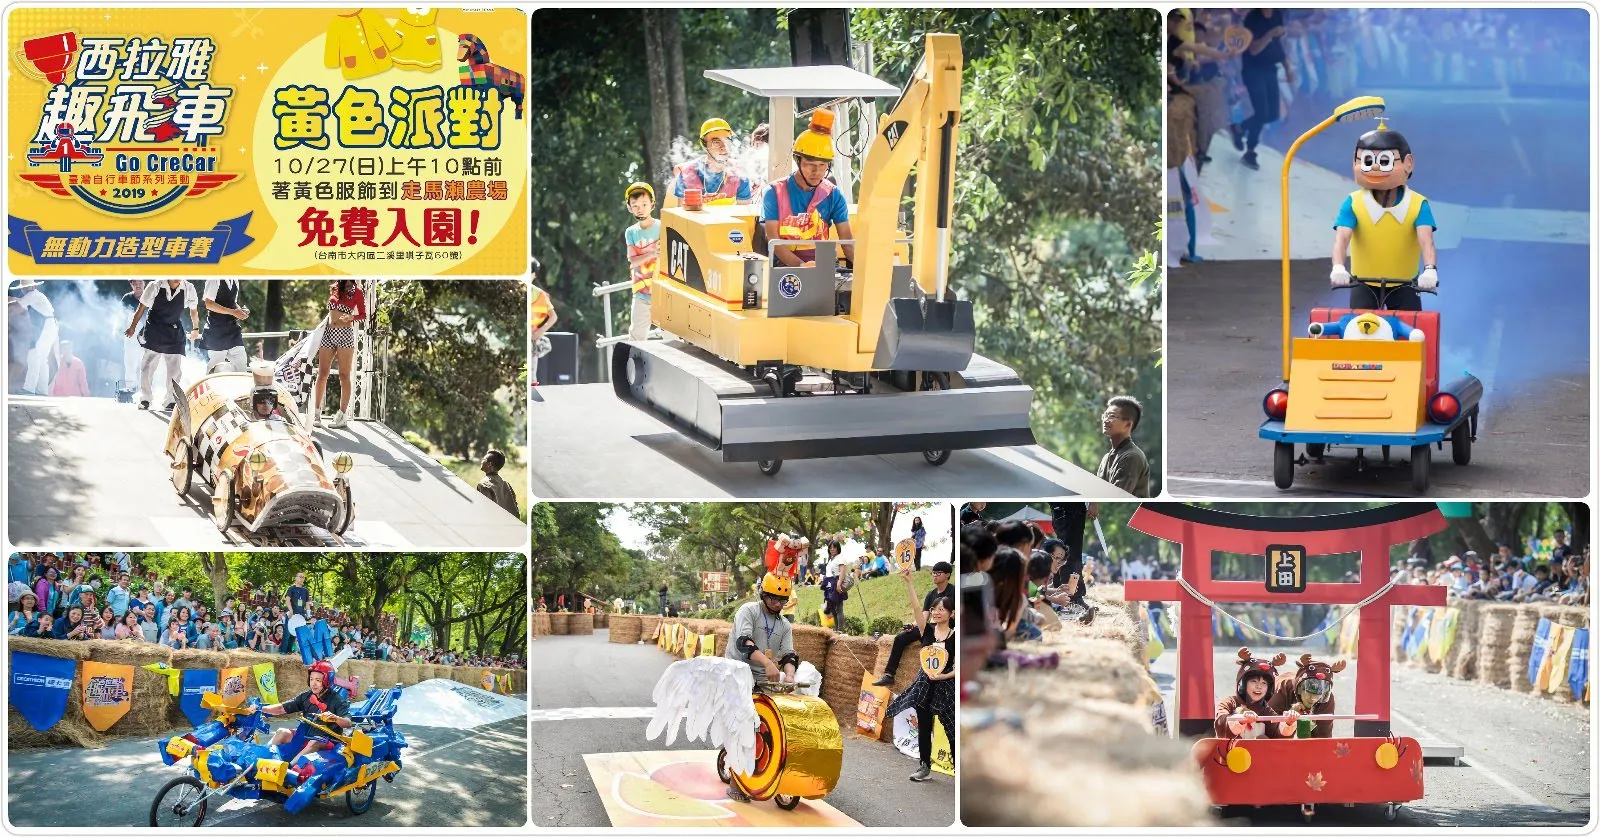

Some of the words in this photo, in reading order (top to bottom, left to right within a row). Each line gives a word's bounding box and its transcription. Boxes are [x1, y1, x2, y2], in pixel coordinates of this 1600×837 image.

[75, 37, 216, 82] 西拉雅
[32, 84, 233, 143] 趣飛車
[272, 84, 504, 150] 黃色派對
[887, 121, 899, 148] CAT
[115, 153, 140, 173] Go
[147, 153, 216, 173] CreCar
[274, 157, 503, 176] 10/27(日)上午10點前
[68, 174, 190, 185] 臺灣自行車節系列活動
[112, 188, 146, 199] 2019
[297, 206, 480, 248] 免費入園!
[41, 236, 214, 259] 無動力造型車賽
[670, 239, 690, 283] CAT
[707, 267, 722, 292] 301
[900, 549, 911, 563] 15
[1277, 550, 1295, 587] 上田
[925, 656, 940, 670] 10
